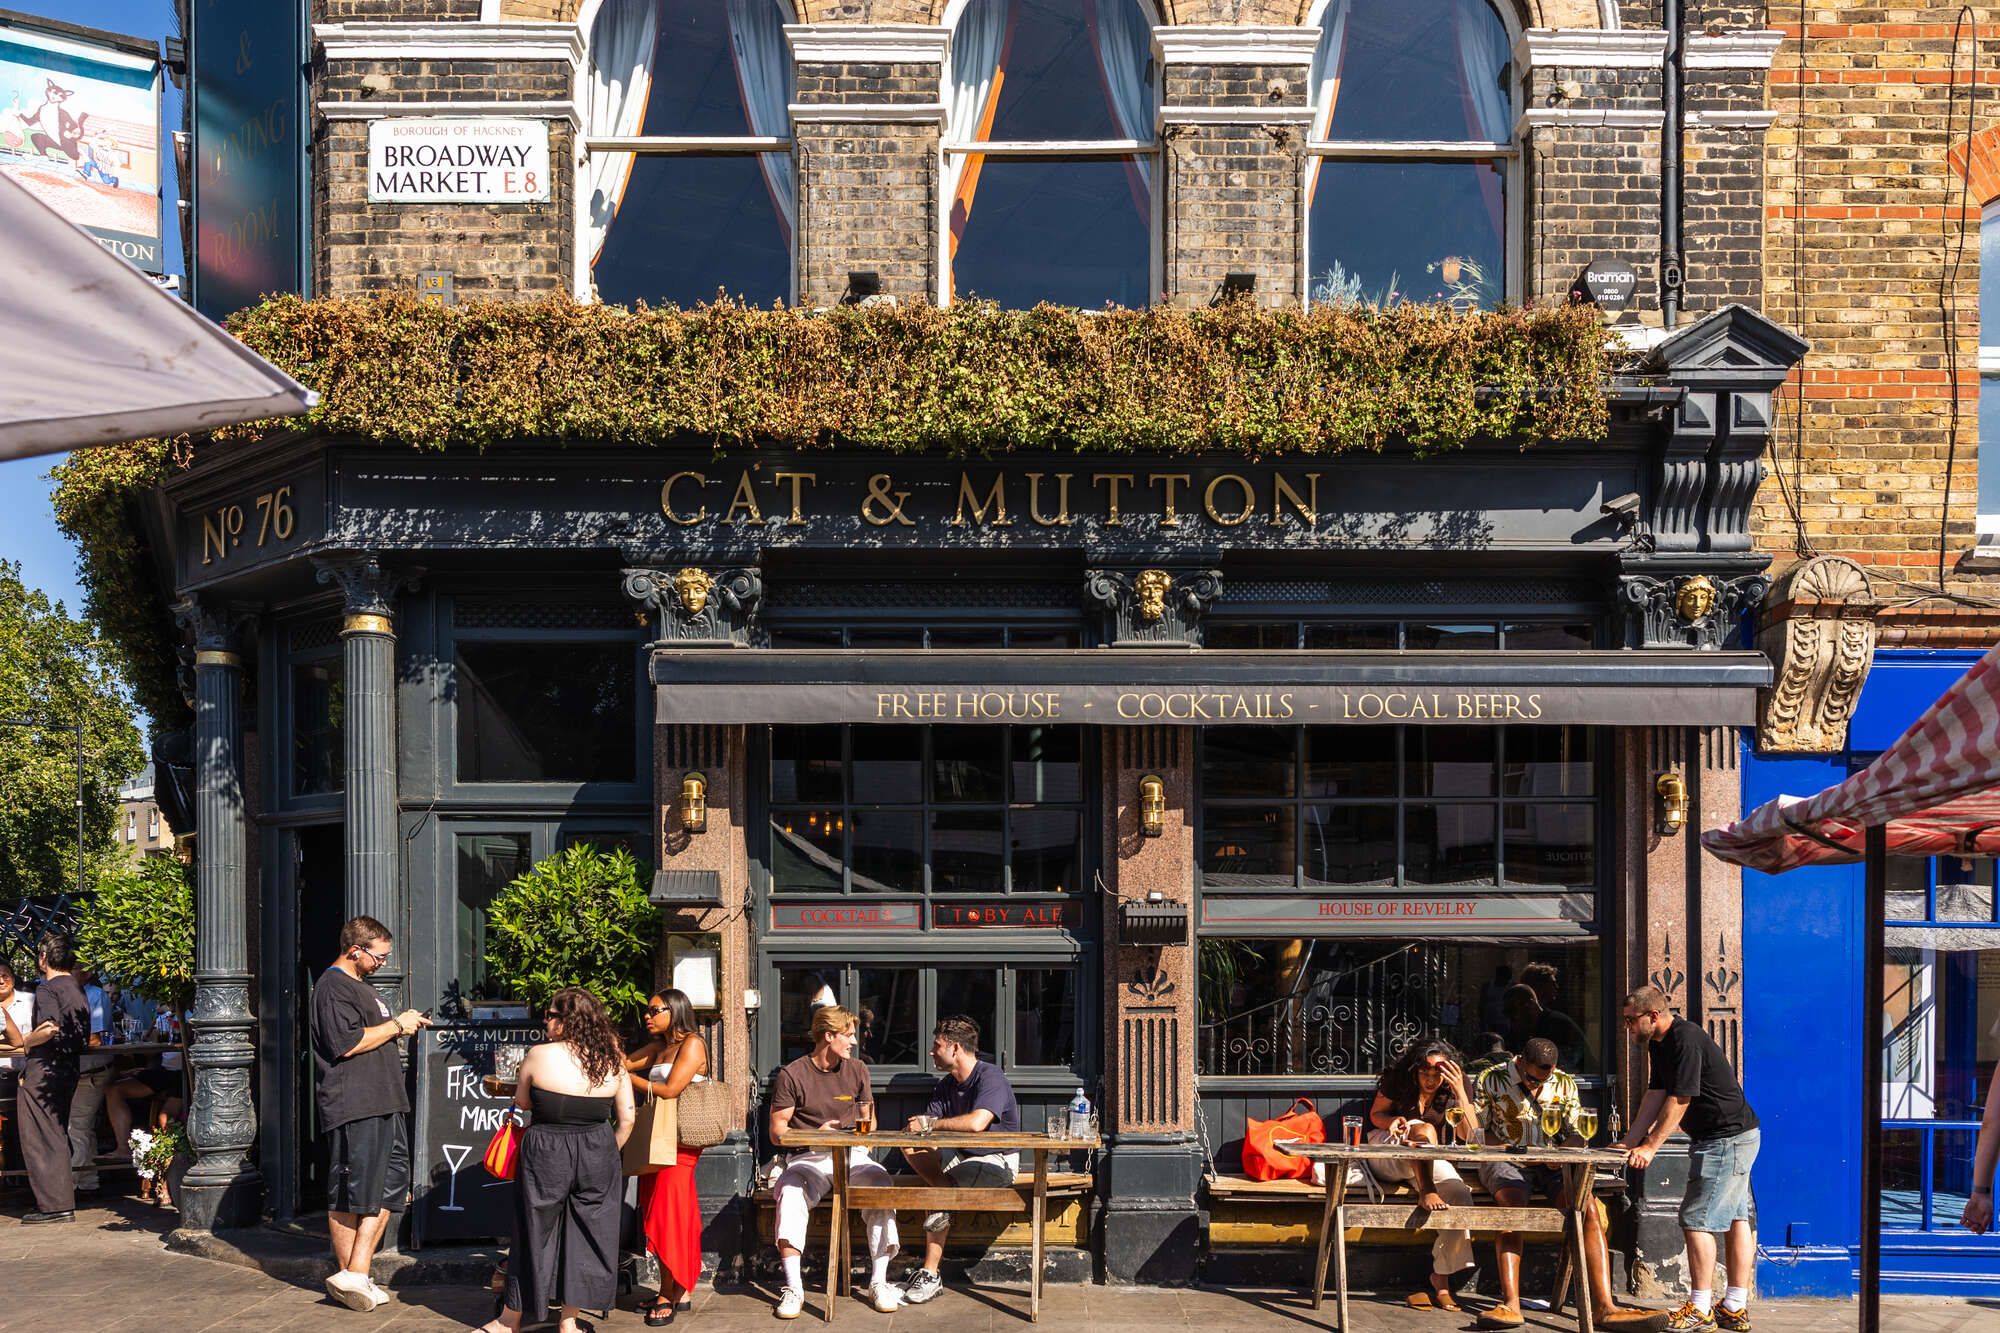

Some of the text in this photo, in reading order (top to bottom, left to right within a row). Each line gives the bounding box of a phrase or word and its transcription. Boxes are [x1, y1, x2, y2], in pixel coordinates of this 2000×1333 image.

[393, 126, 524, 136] BOROUGH OF HACKNEY
[384, 145, 532, 167] BROADWAY
[376, 171, 542, 194] MARKET. E.8.
[210, 196, 280, 273] ROOM
[1587, 271, 1635, 283] Bramah
[661, 470, 1321, 527] CAT & MUTTON
[256, 486, 294, 547] 76
[877, 693, 947, 719] FREE
[955, 693, 1060, 719] HOUSE
[1117, 693, 1294, 719] COCKTAILS
[1343, 693, 1448, 719] LOCAL
[1456, 693, 1542, 719] BEERS
[801, 909, 893, 923] COCKTAILS
[1319, 902, 1478, 915] HOUSE OF REVELRY
[436, 1029, 468, 1043] CAT
